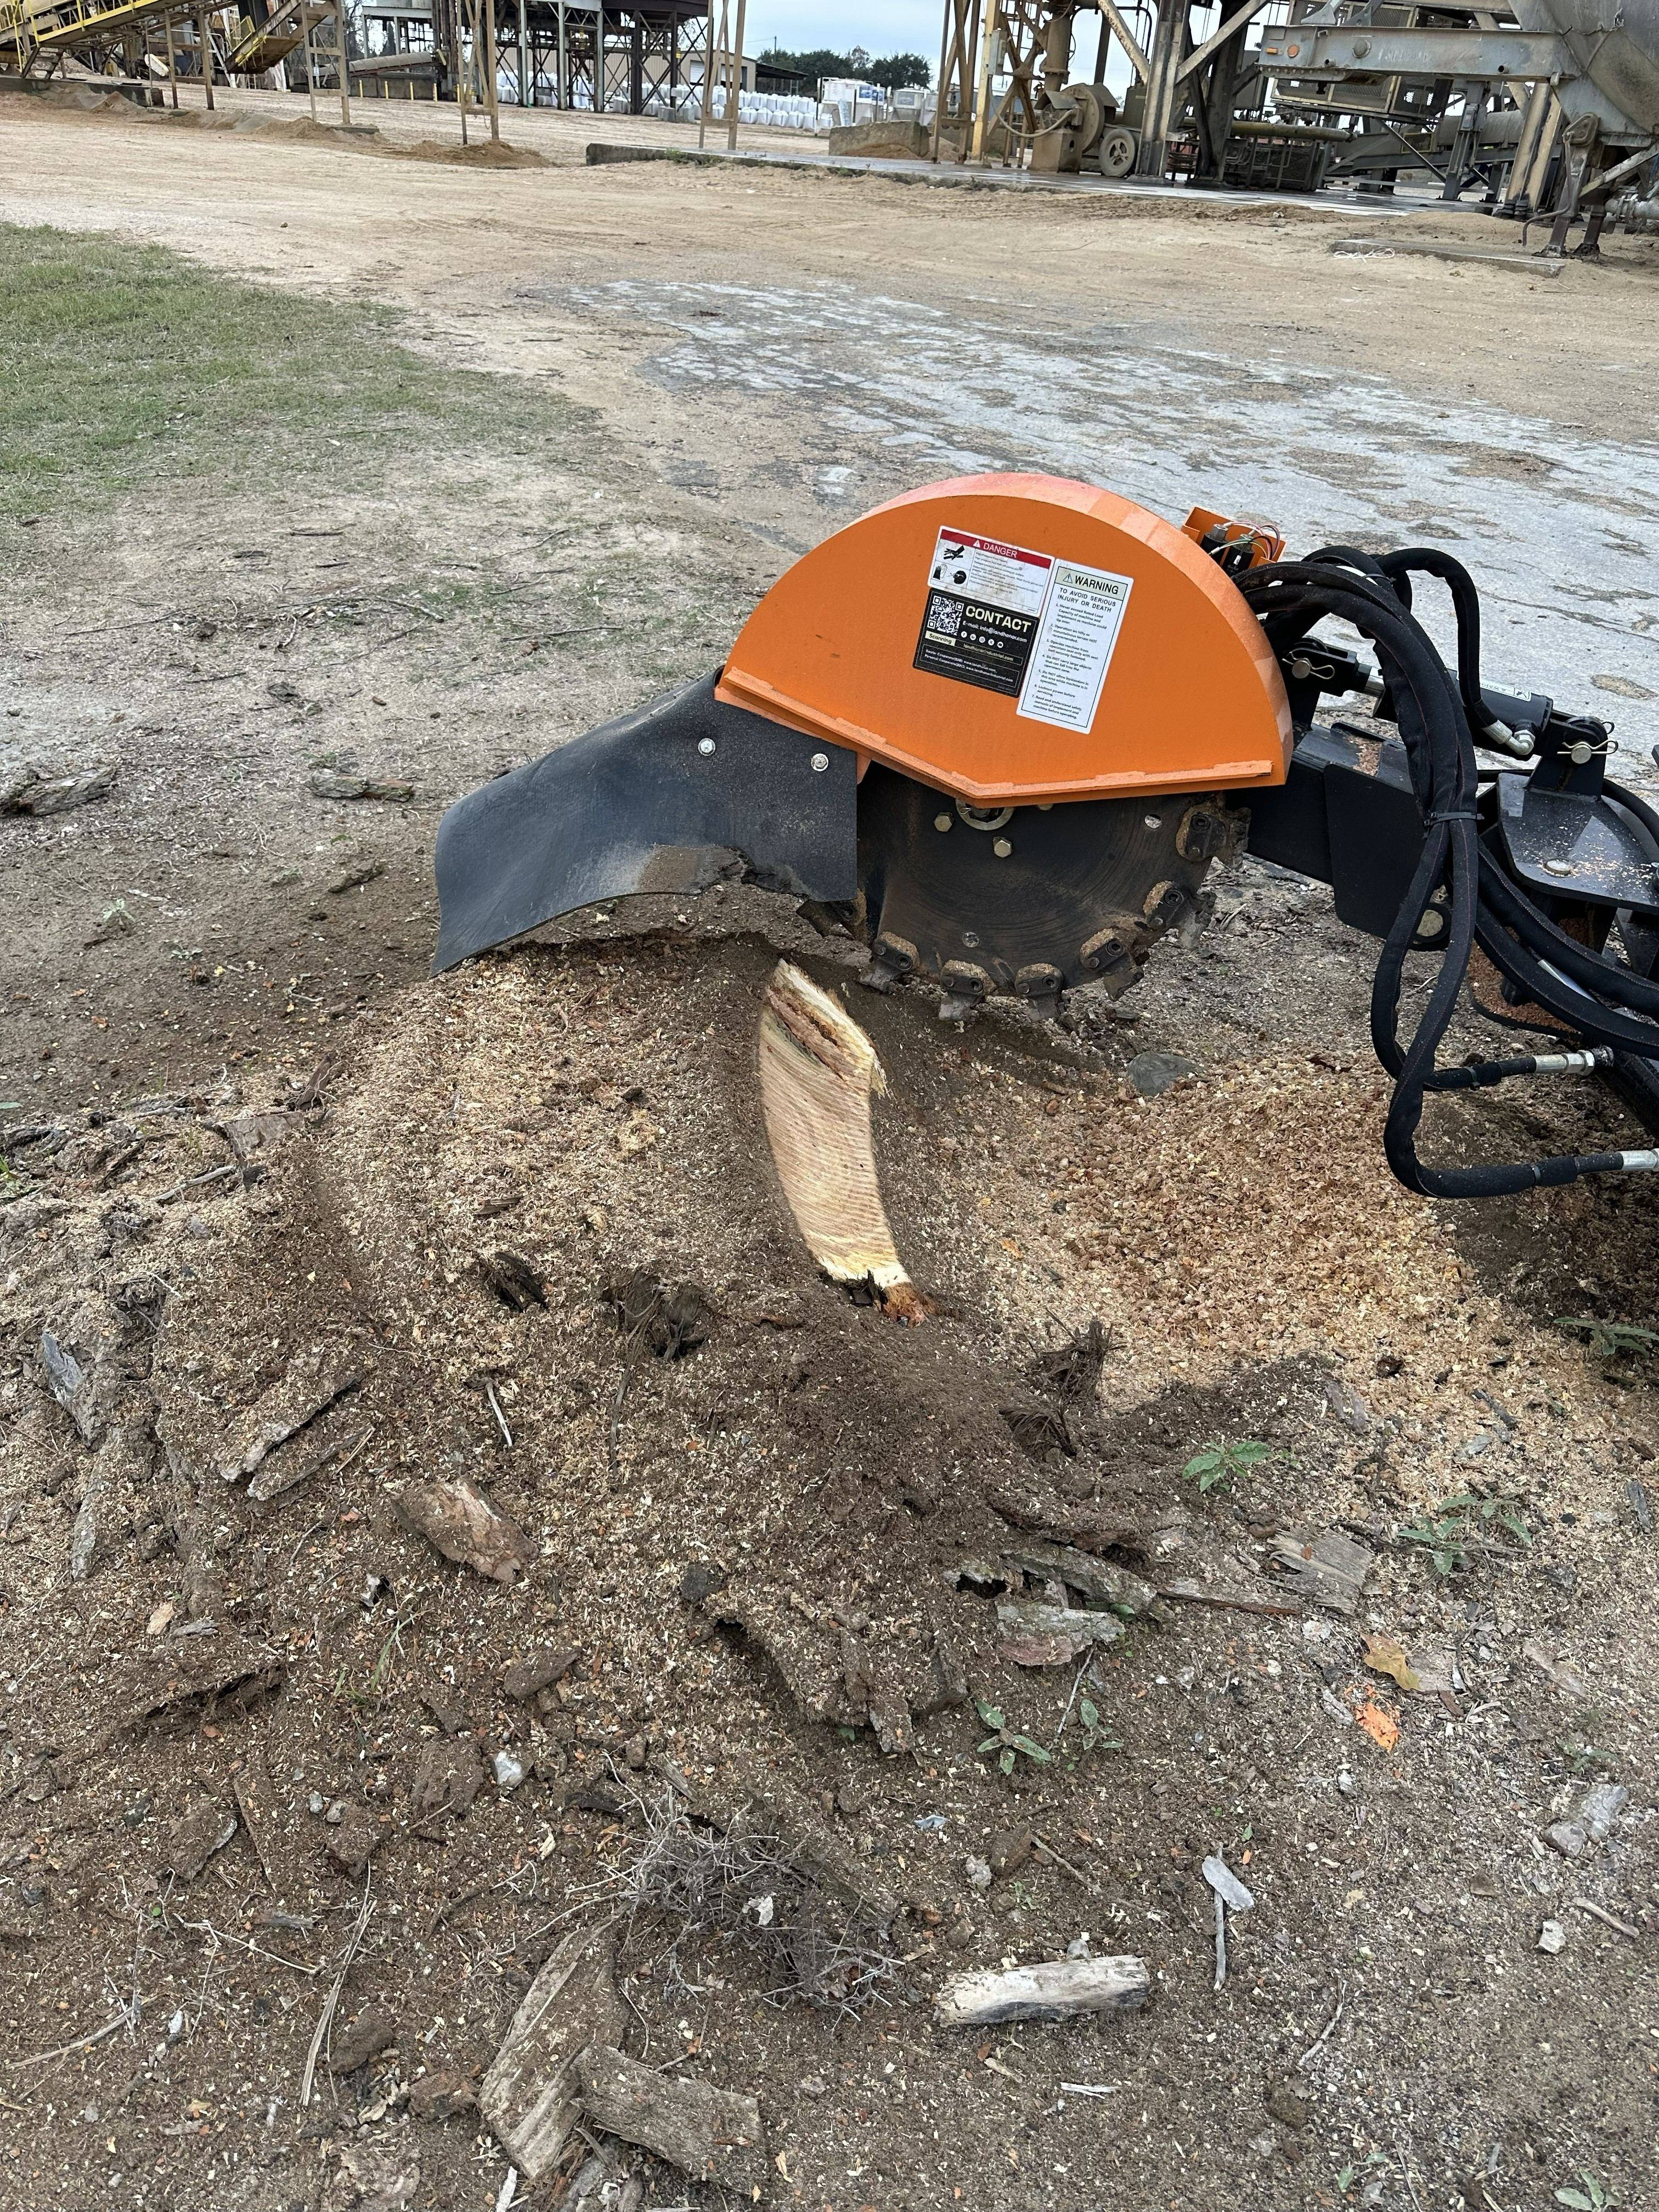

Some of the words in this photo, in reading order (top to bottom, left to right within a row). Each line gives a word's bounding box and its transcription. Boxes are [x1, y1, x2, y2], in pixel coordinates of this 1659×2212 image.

[983, 543, 1017, 558] DANGER
[1075, 575, 1118, 594] WARNING
[1057, 594, 1079, 603] INJURY
[1092, 603, 1111, 612] DEATH
[1069, 590, 1087, 599] AVOID
[1090, 596, 1116, 606] SERIOUS
[966, 606, 1031, 632] CONTACT
[929, 633, 952, 644] Scanning
[962, 620, 979, 629] E-mail:
[979, 625, 1026, 642] info@landhonor.com
